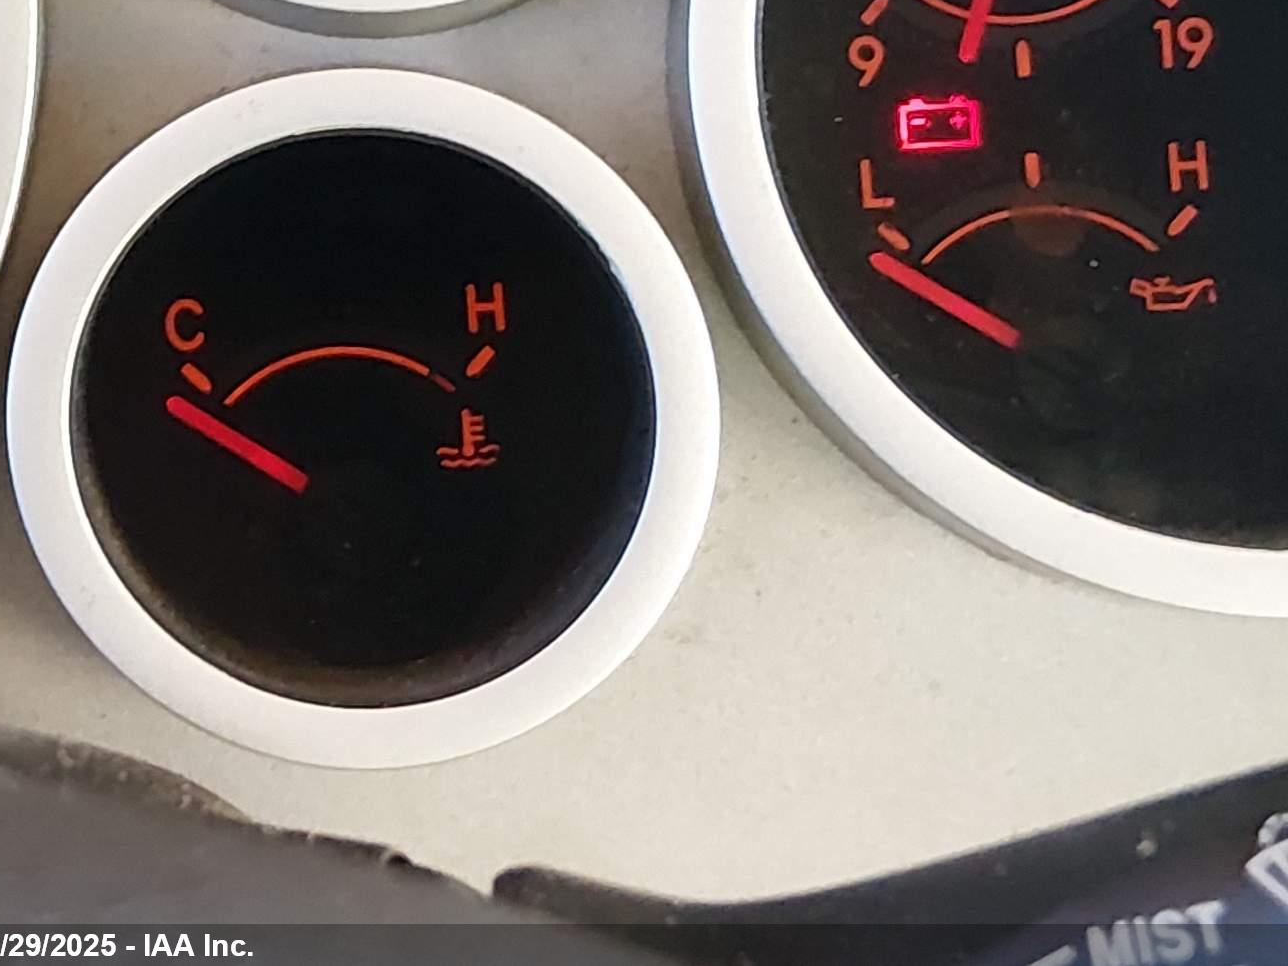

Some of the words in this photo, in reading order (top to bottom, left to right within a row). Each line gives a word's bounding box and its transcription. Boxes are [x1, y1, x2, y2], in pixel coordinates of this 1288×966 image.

[848, 35, 885, 87] 9
[1153, 17, 1214, 69] 19
[859, 159, 895, 209] L
[1167, 140, 1209, 192] H
[164, 298, 205, 352] C
[465, 282, 506, 333] H
[1087, 899, 1227, 966] MIST
